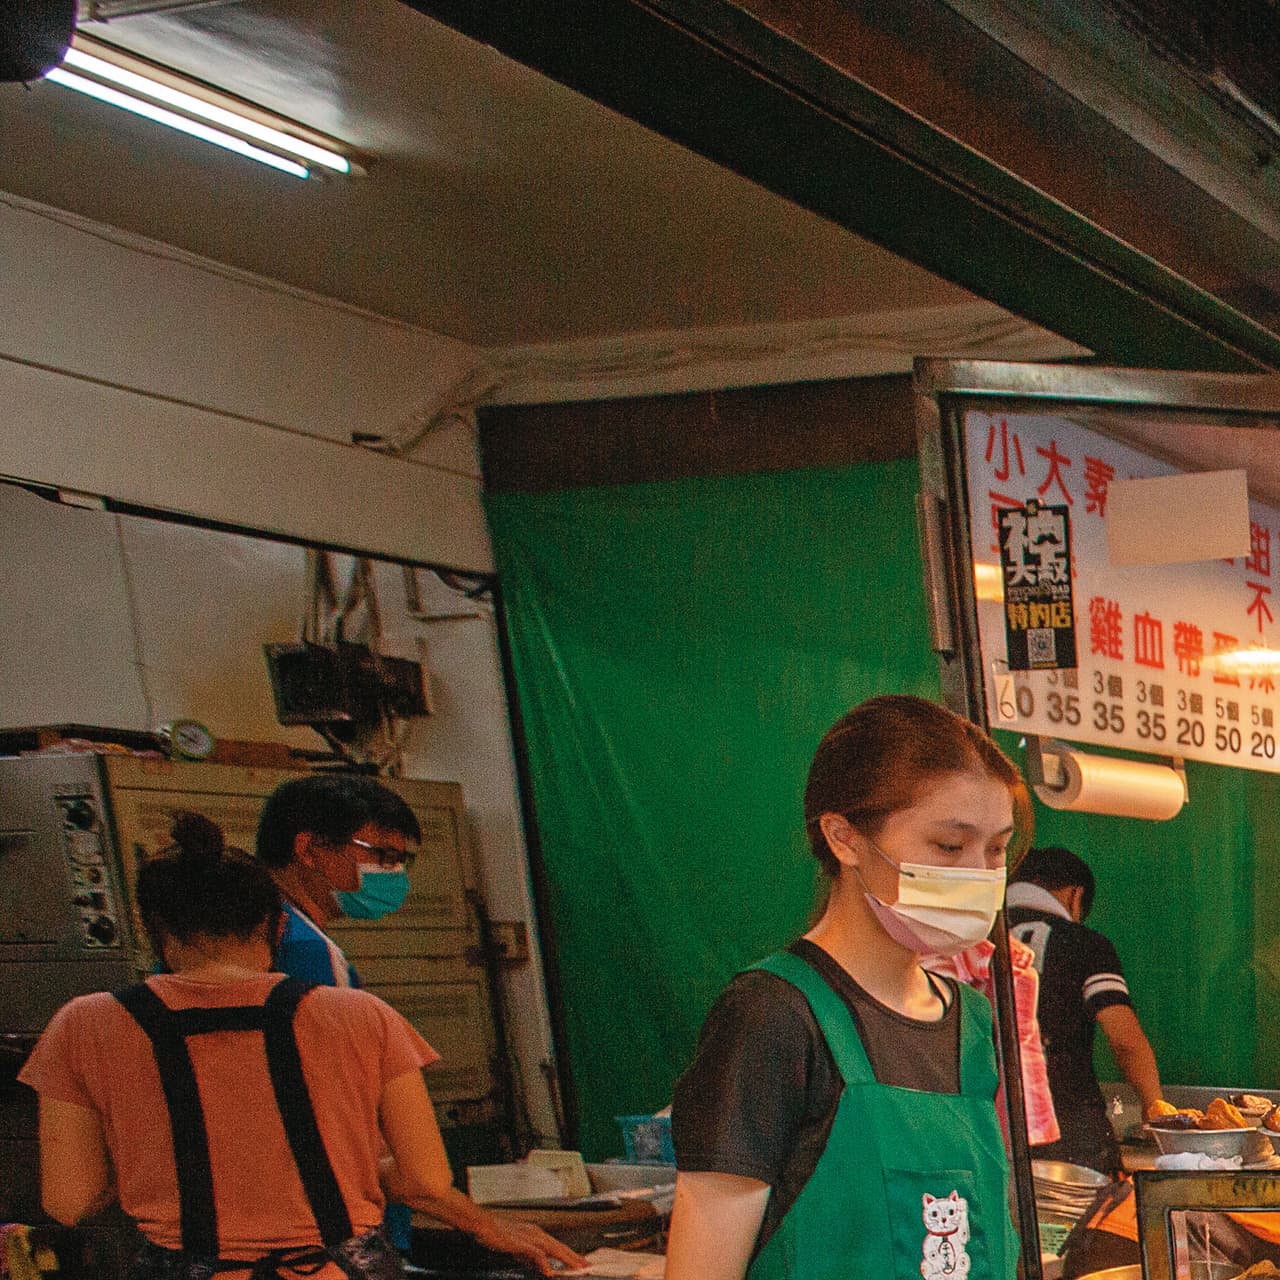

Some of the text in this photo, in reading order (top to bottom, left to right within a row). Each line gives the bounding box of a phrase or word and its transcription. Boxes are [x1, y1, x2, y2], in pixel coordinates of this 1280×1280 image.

[1007, 601, 1072, 630] 特約店
[1046, 691, 1081, 726] 35
[1093, 702, 1126, 733] 35
[1136, 710, 1166, 741] 35
[1177, 718, 1205, 748] 20
[1215, 725, 1241, 754] 50
[1251, 731, 1276, 759] 20
